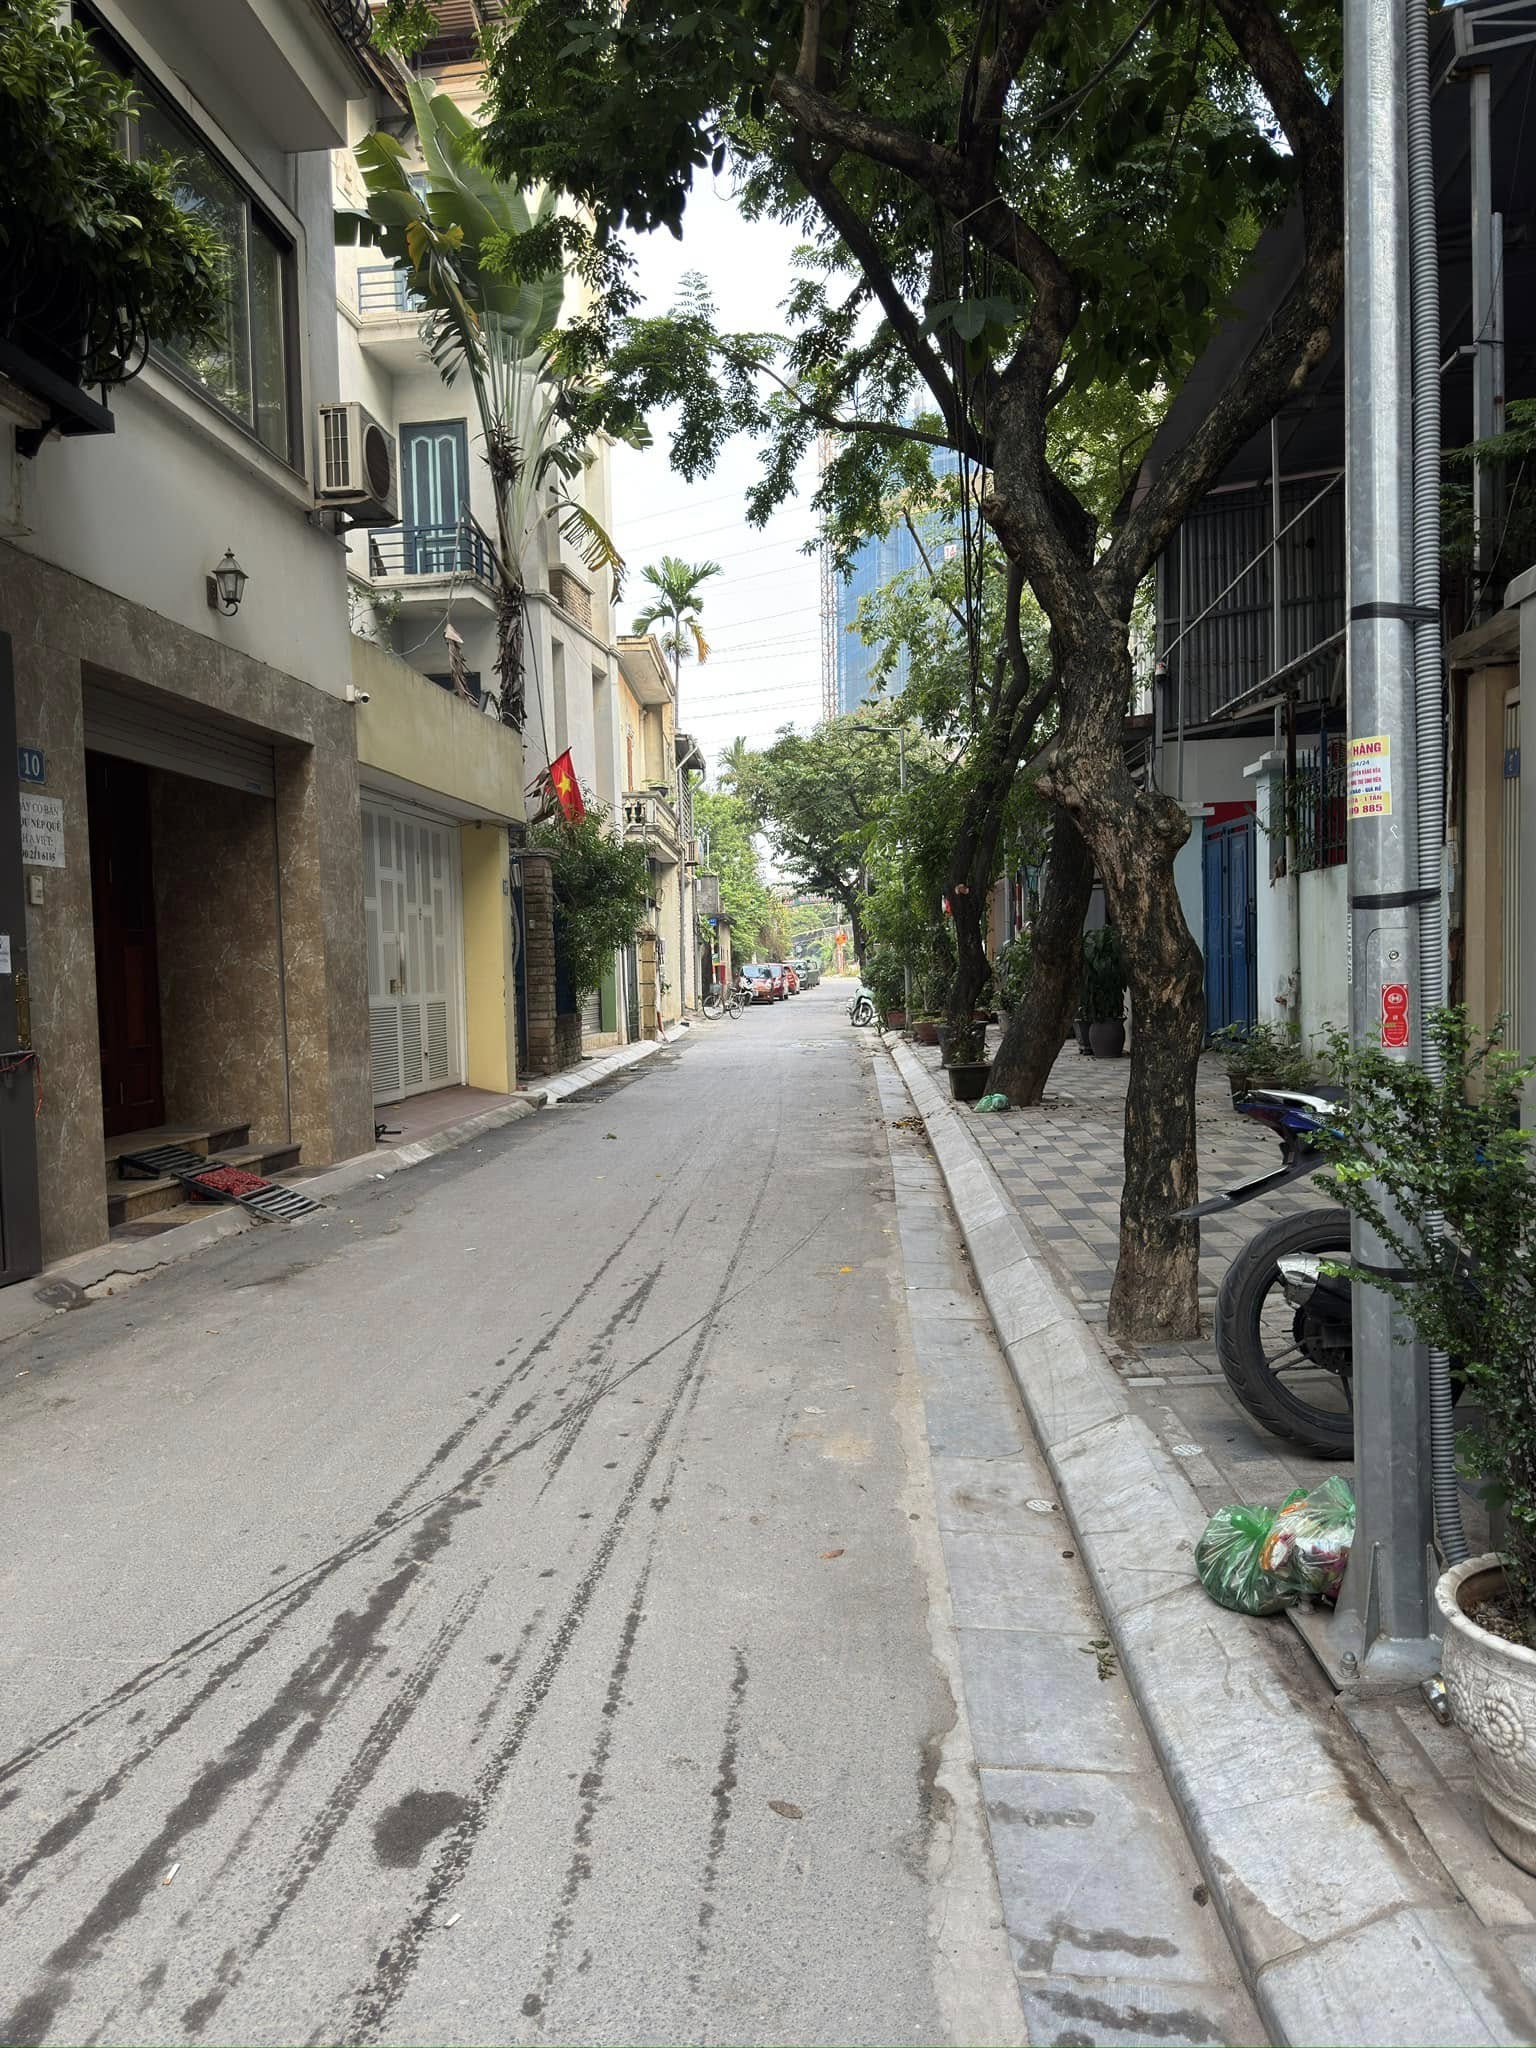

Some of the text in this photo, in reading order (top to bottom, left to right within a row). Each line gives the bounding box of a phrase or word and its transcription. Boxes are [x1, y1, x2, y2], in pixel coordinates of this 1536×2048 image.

[1353, 742, 1381, 756] HÀNG
[24, 752, 40, 776] 10
[1362, 803, 1383, 813] 885
